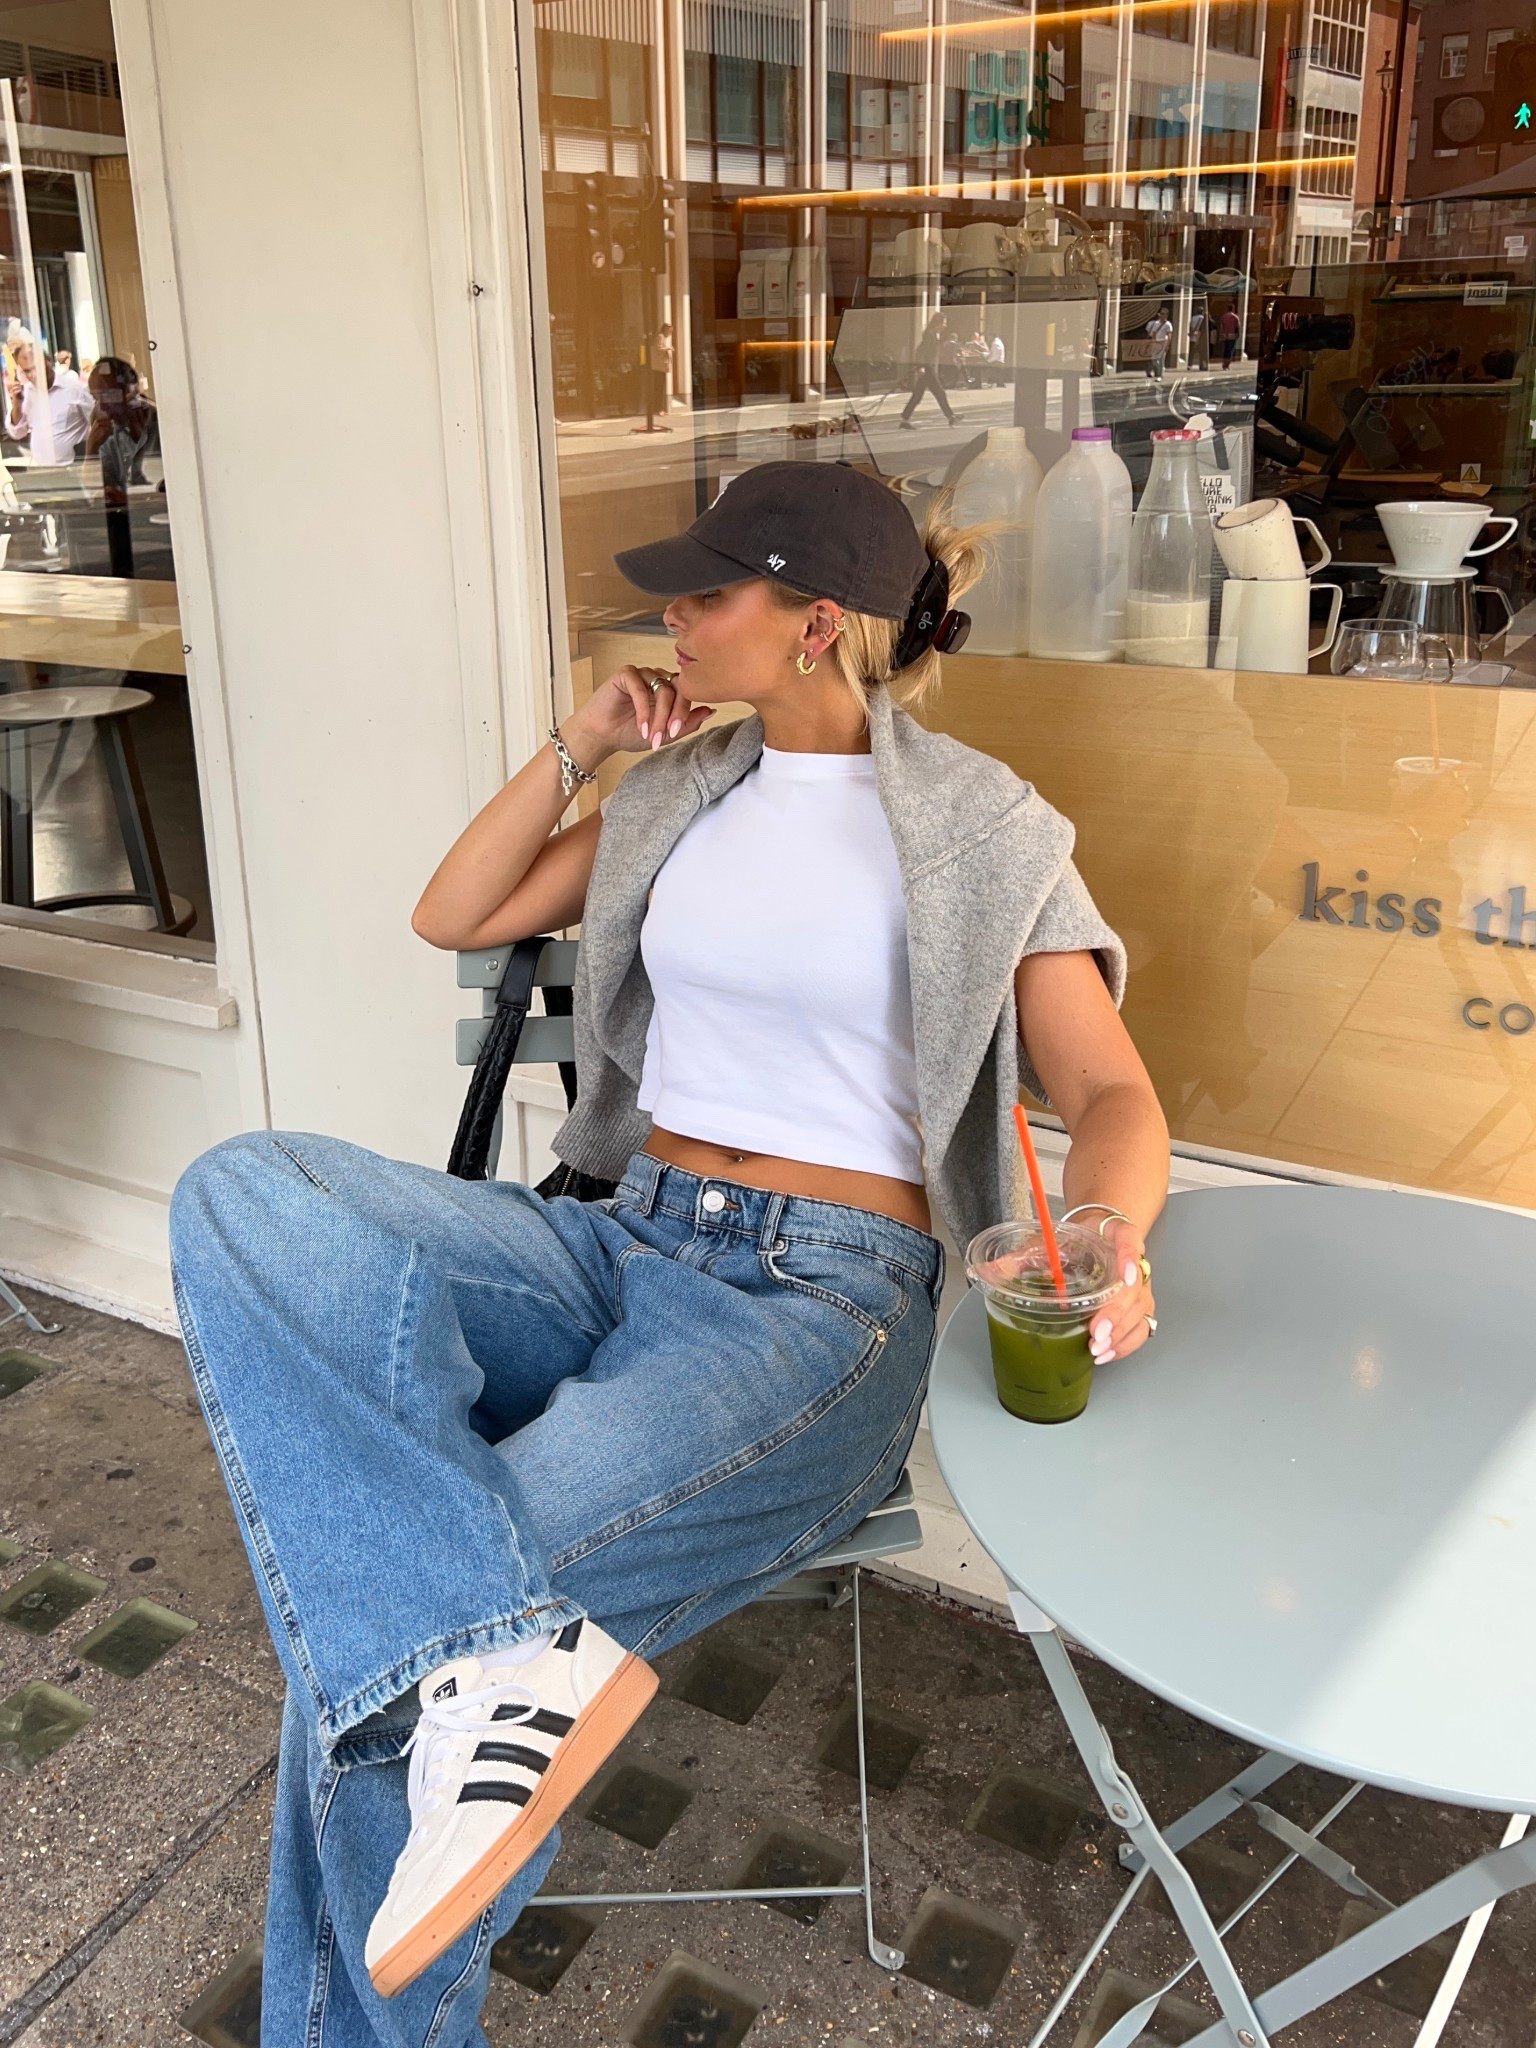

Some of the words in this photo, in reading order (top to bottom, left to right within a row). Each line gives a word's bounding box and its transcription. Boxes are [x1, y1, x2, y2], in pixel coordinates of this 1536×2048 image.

[918, 611, 933, 630] alo
[1299, 862, 1442, 938] kiss
[1473, 885, 1536, 950] th
